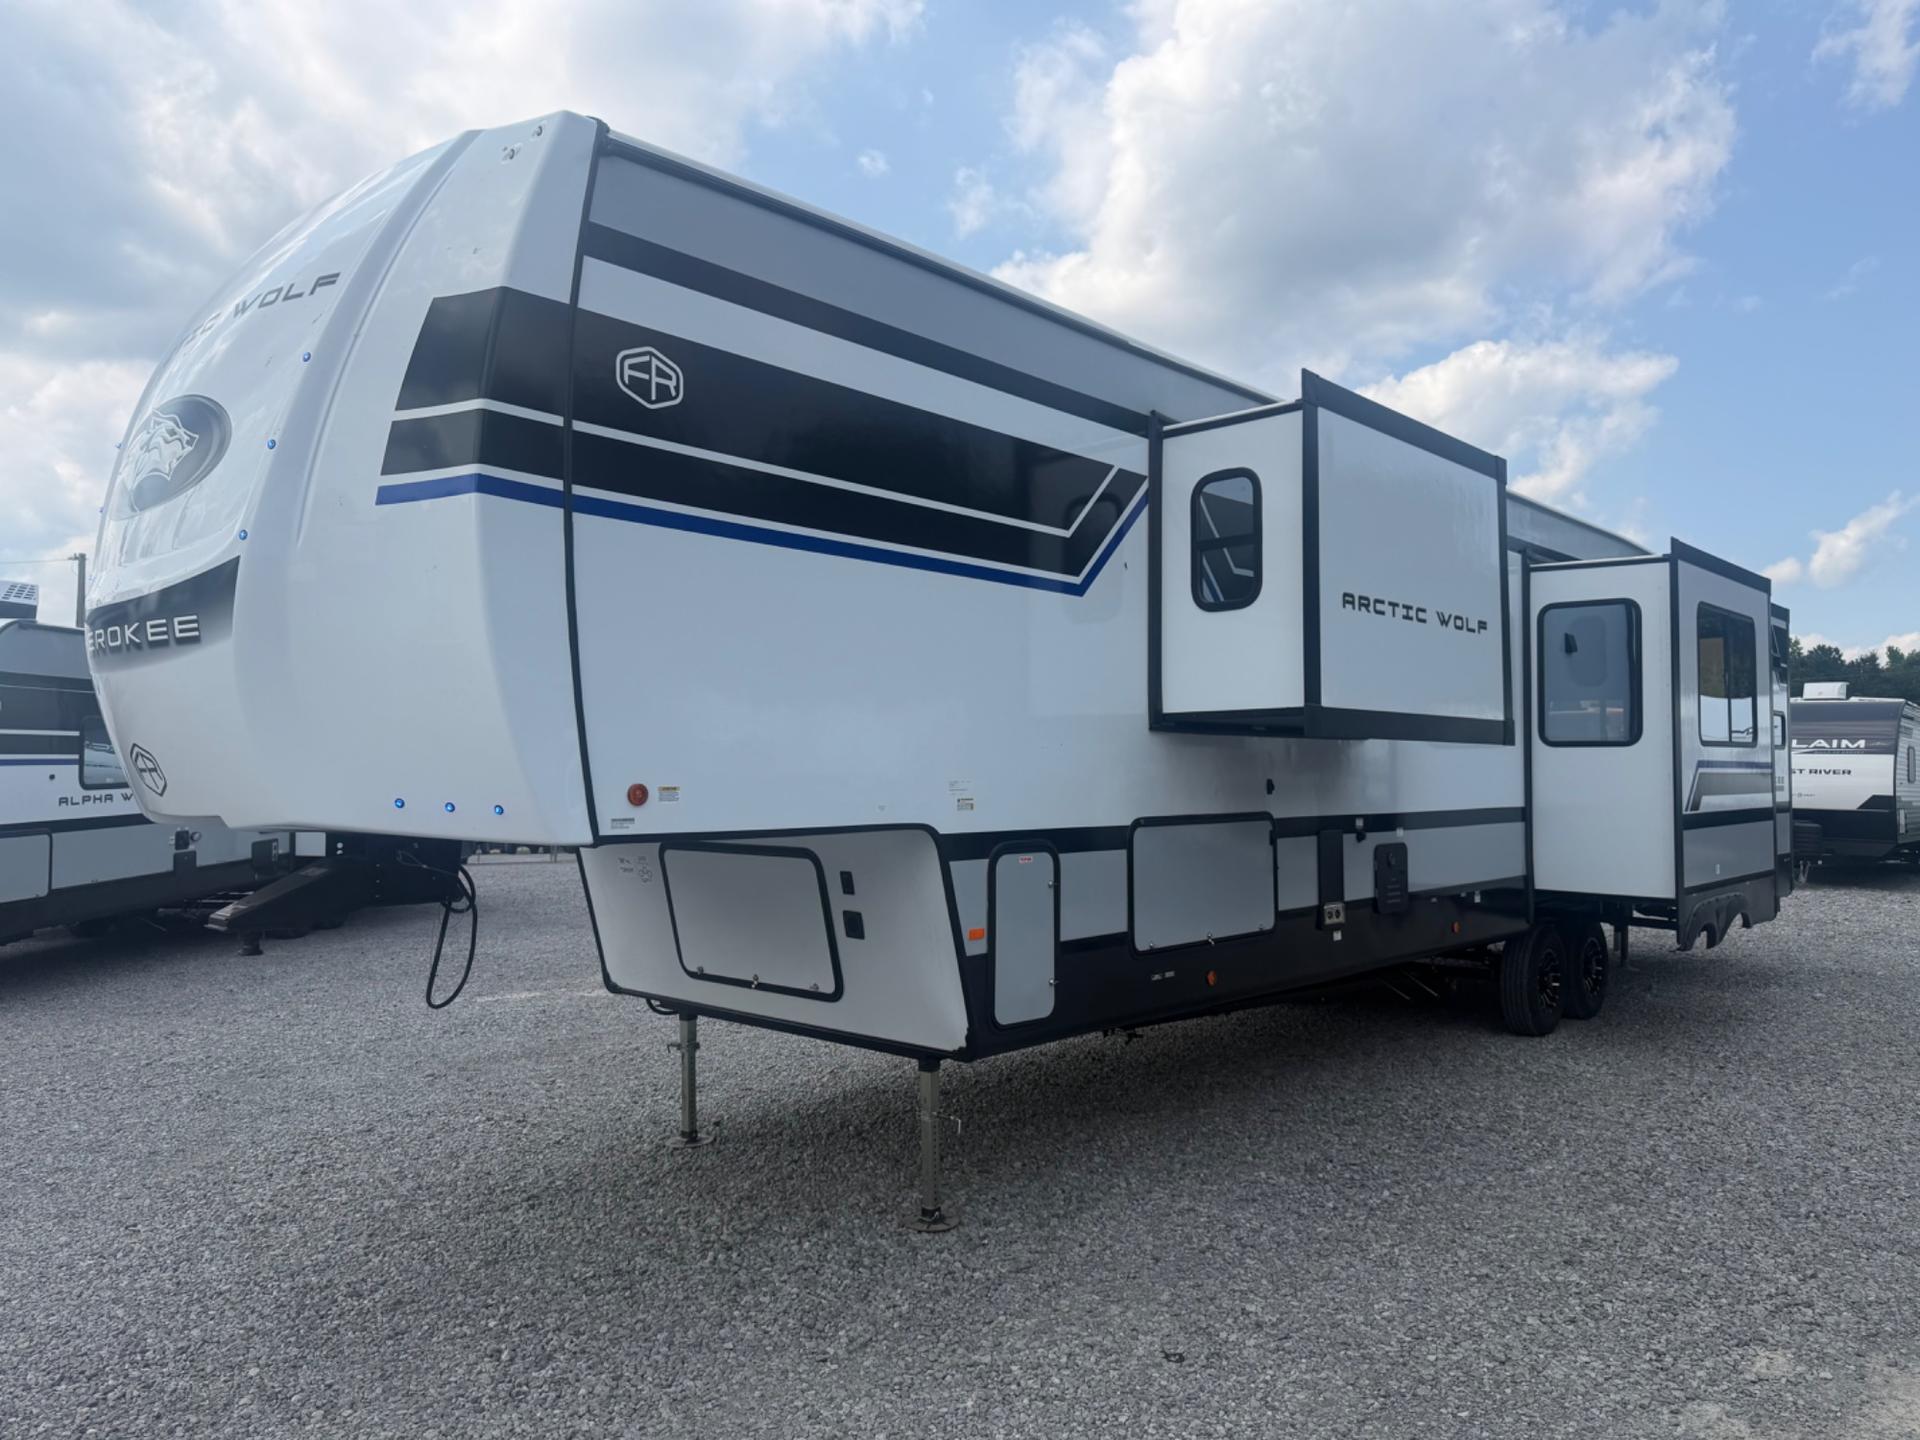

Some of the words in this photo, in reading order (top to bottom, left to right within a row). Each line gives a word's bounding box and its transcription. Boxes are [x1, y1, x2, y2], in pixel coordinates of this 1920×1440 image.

[233, 272, 341, 318] WOLF
[1342, 592, 1427, 624] ARCTIC
[1436, 611, 1488, 634] WOLF
[1809, 768, 1851, 776] RIVER
[58, 794, 113, 806] ALPHA
